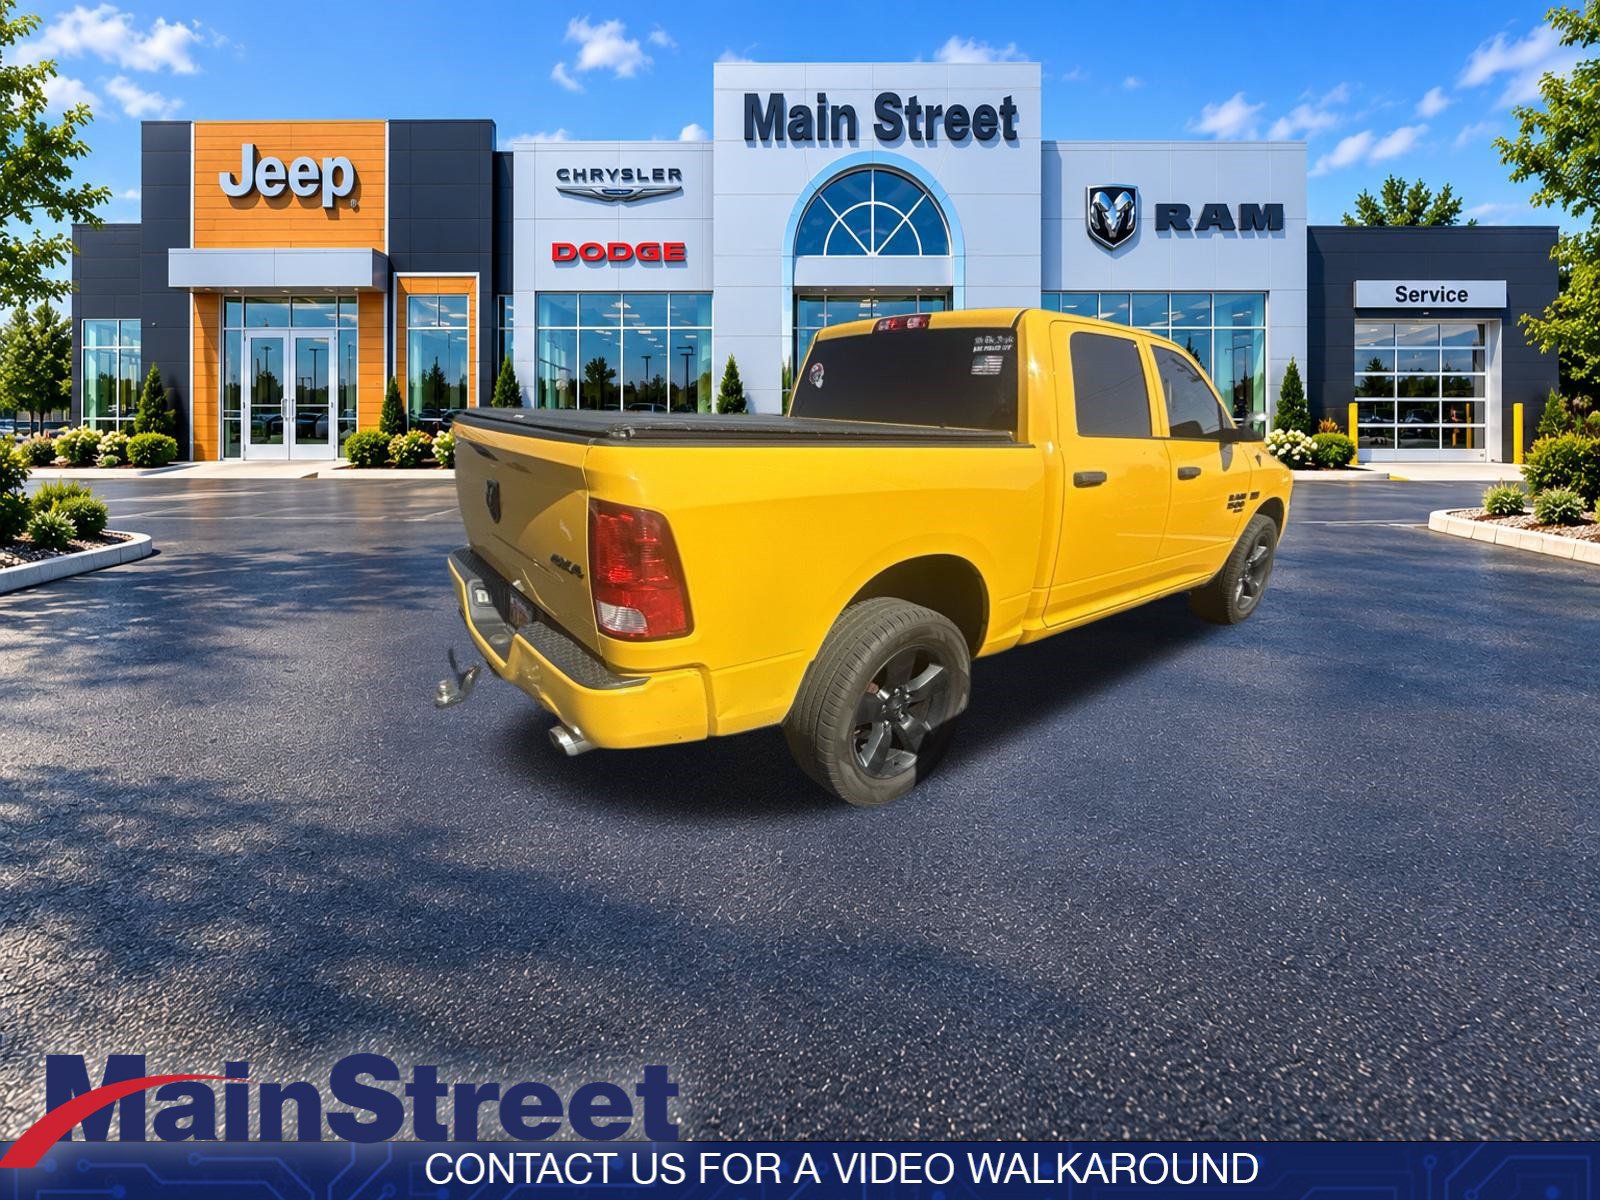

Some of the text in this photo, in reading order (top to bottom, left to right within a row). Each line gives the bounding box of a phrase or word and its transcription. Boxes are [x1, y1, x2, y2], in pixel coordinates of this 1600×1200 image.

[744, 92, 1018, 142] Main Street
[218, 143, 355, 208] Jeep
[556, 167, 682, 182] CHRYSLER
[1155, 203, 1284, 232] RAM
[551, 242, 686, 261] DODGE
[1395, 285, 1469, 303] Service
